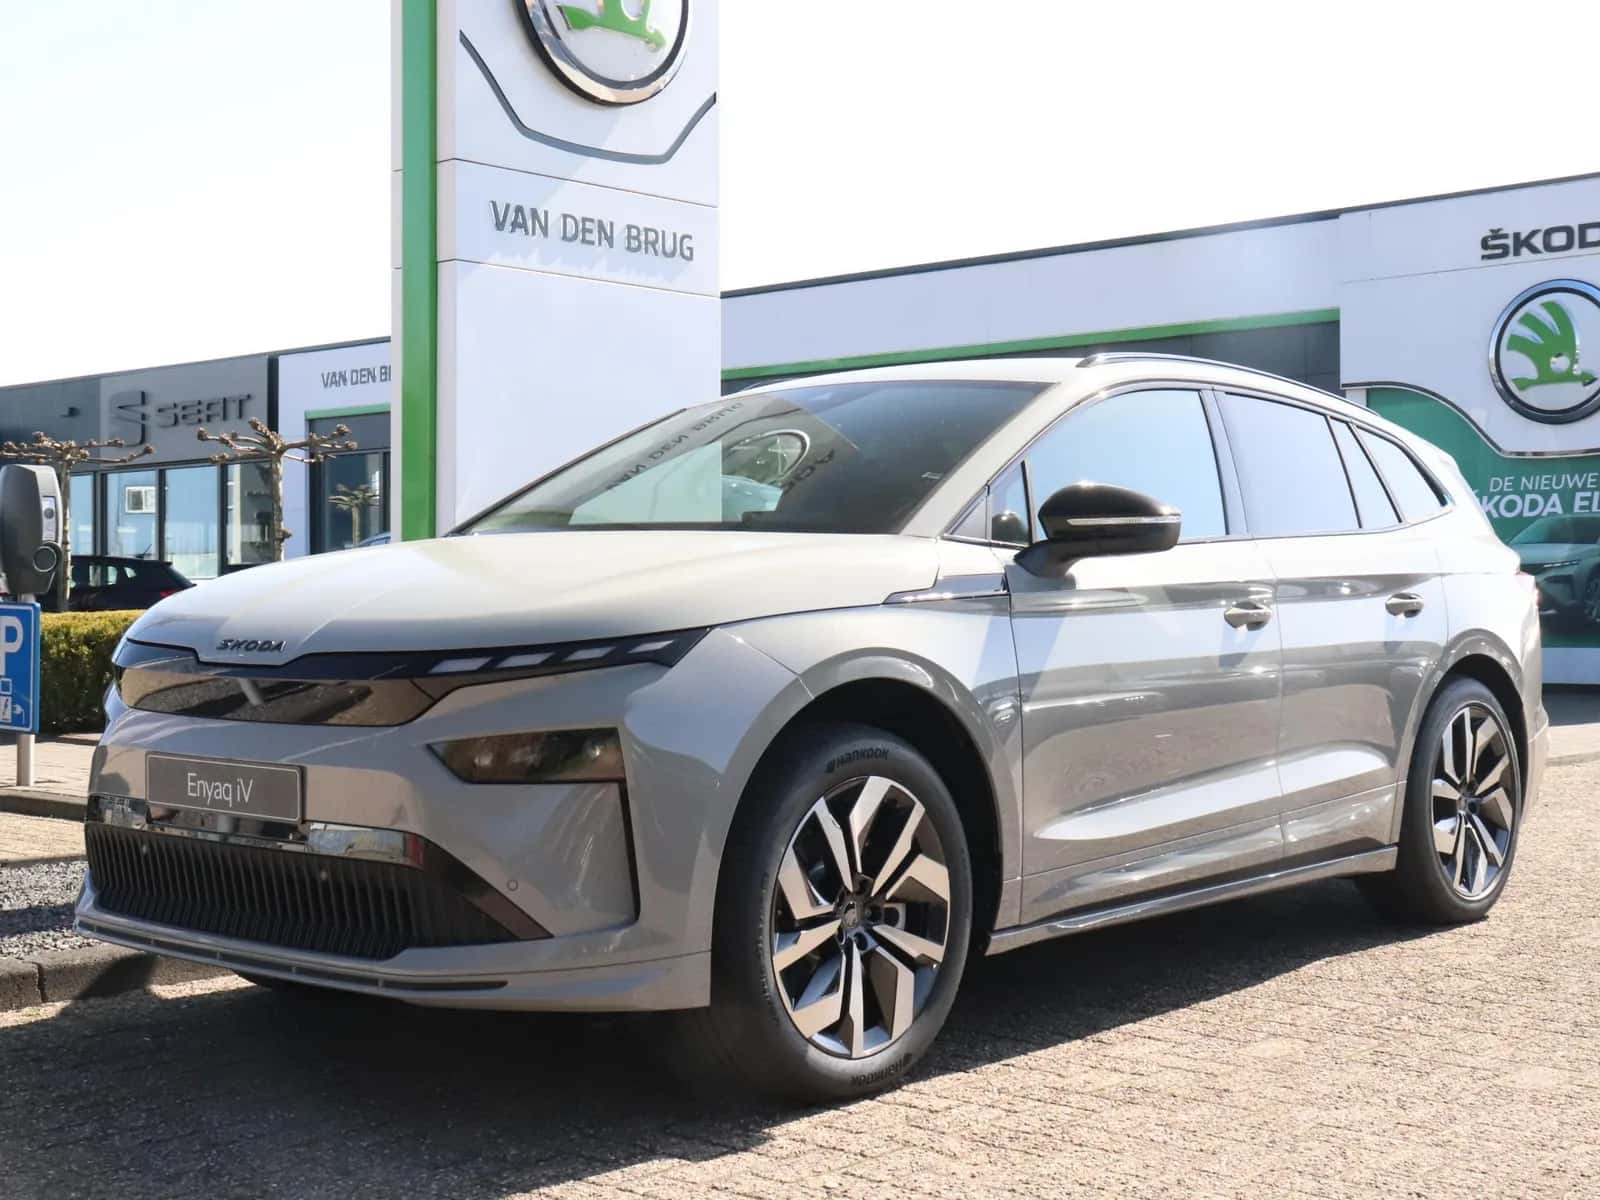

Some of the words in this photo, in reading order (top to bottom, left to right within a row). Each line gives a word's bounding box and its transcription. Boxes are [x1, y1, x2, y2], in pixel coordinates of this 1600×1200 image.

[490, 200, 549, 238] VAN
[561, 213, 614, 249] DEN
[625, 224, 694, 261] BRUG
[320, 370, 347, 388] VAN
[350, 367, 376, 386] DEN
[156, 393, 253, 428] SEAT
[1489, 476, 1514, 492] DE
[1520, 472, 1599, 491] NIEUWE
[1472, 489, 1564, 518] KODA
[187, 772, 233, 808] Enyaq
[236, 778, 254, 803] iV
